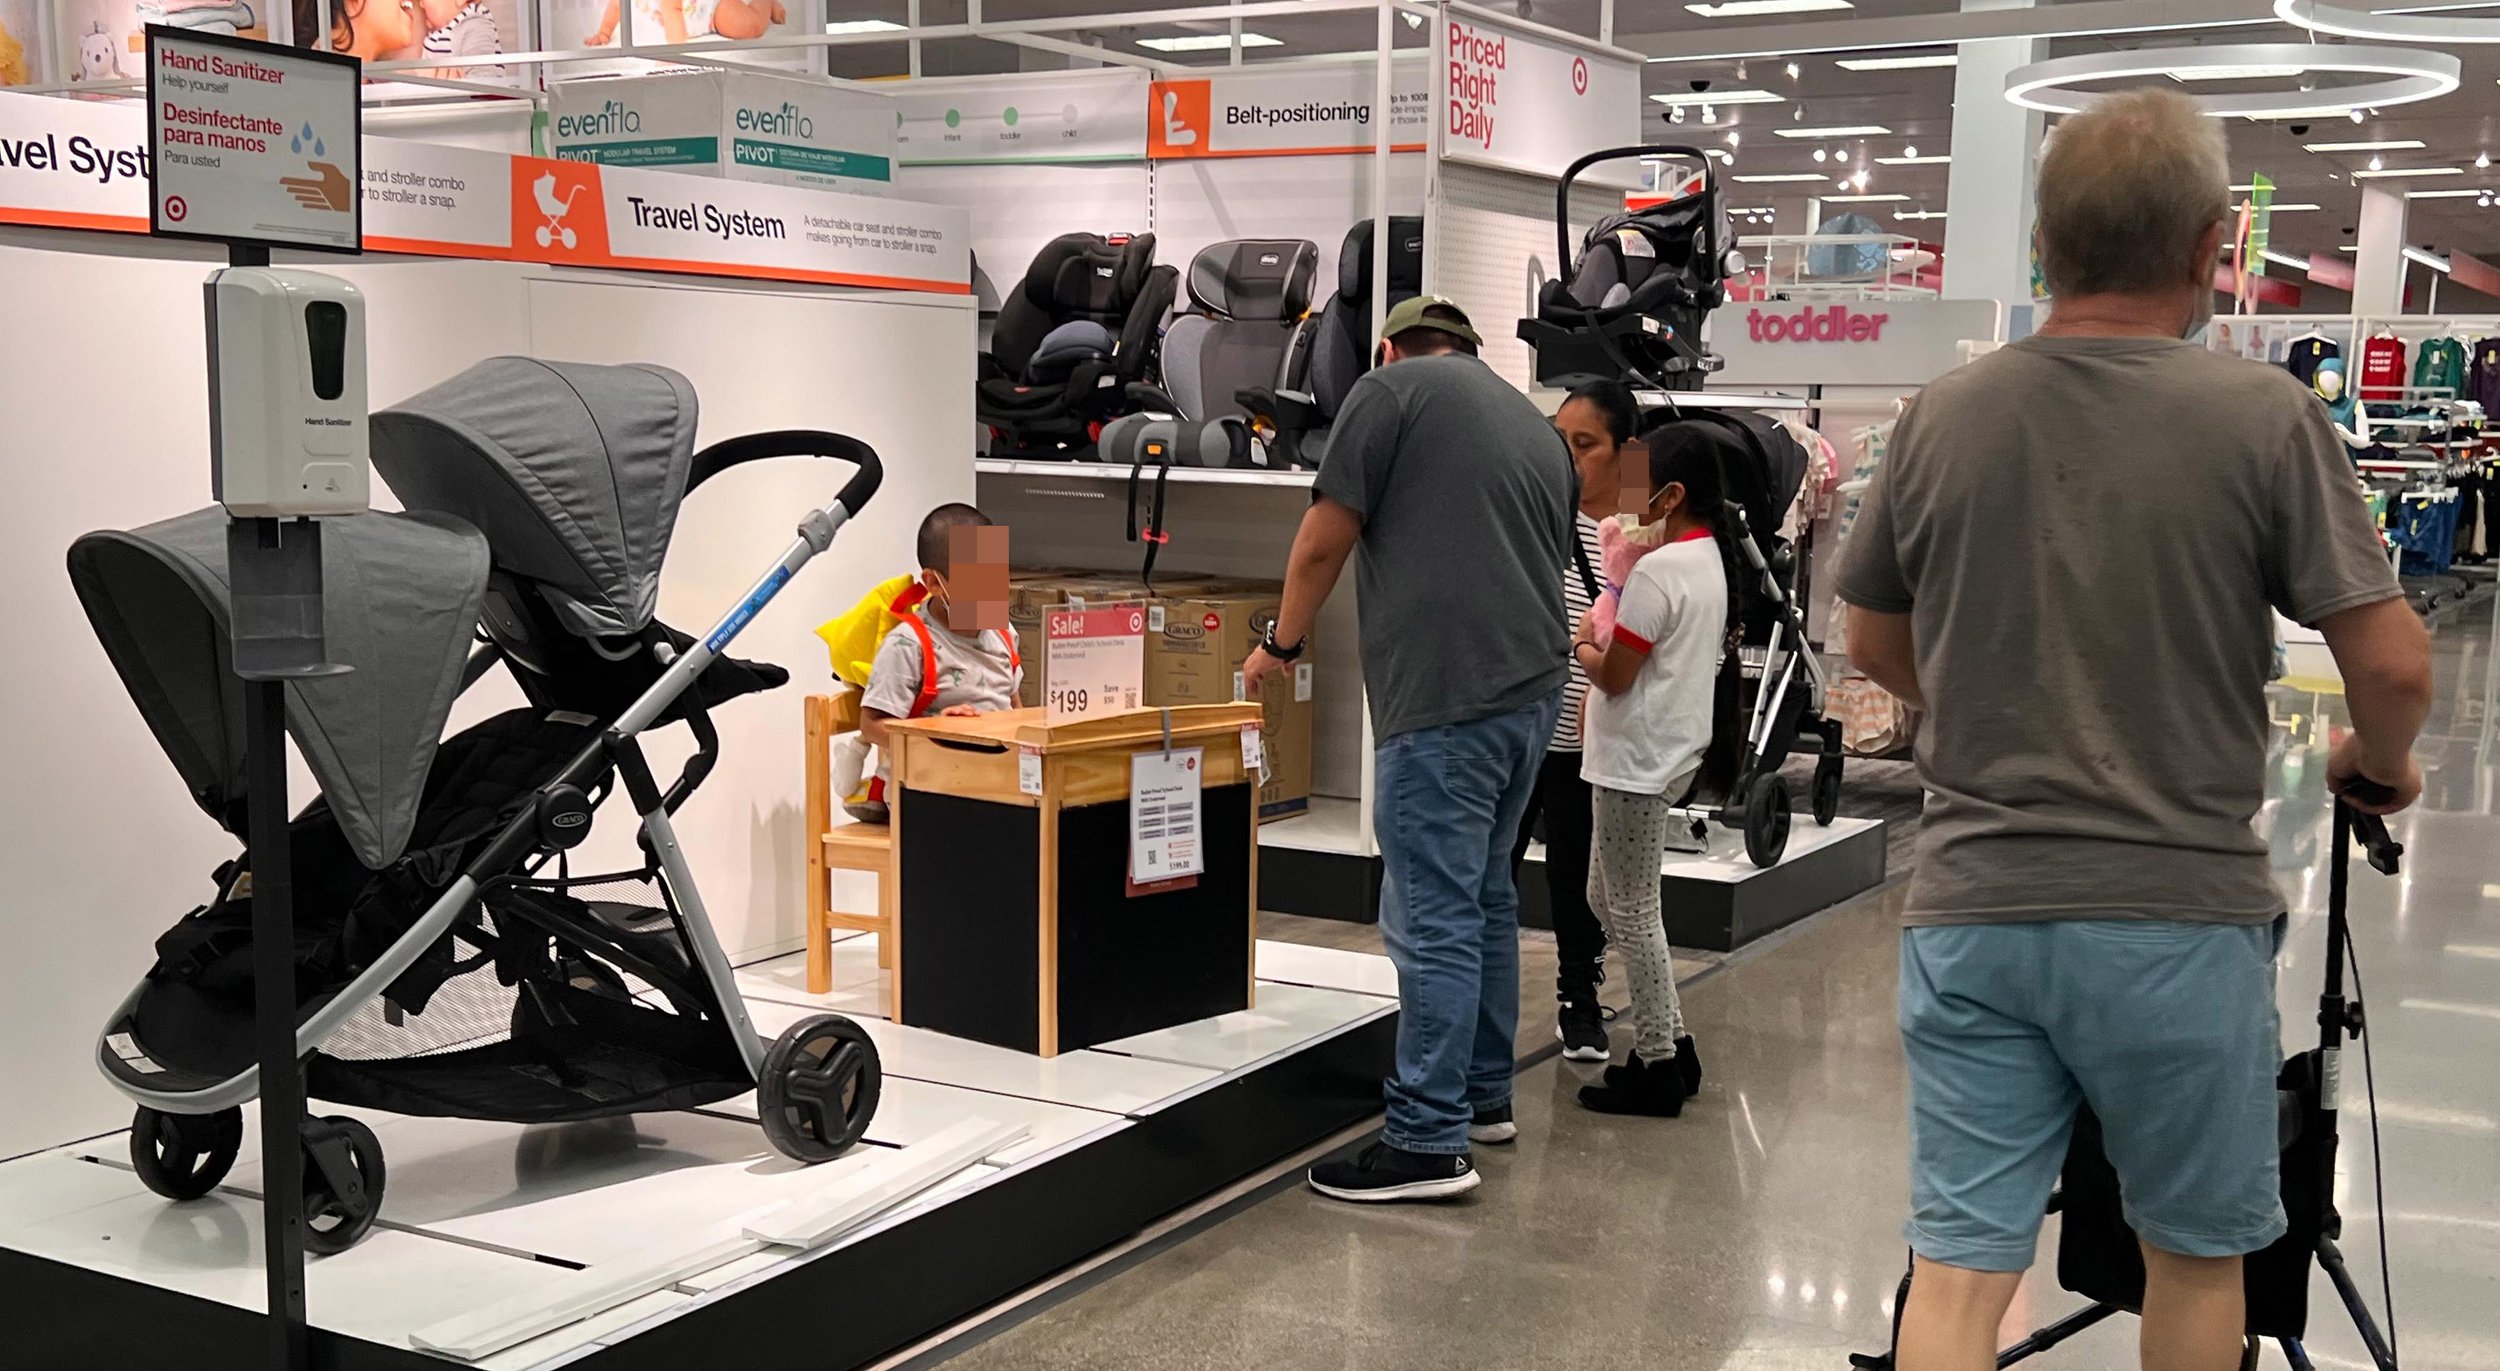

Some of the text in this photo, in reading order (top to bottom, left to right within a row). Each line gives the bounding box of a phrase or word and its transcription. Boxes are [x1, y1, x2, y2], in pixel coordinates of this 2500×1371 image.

[1449, 22, 1505, 70] Priced
[161, 48, 285, 84] Hand Sanitizer
[162, 74, 229, 94] Help yourself
[1450, 61, 1496, 109] Right
[163, 102, 283, 135] Desinfectante
[557, 100, 640, 137] evenflo
[736, 102, 813, 139] evenflo
[1226, 102, 1370, 127] Belt-positioning
[1450, 99, 1494, 149] Daily
[0, 133, 58, 171] vel
[164, 127, 266, 153] para manos
[164, 150, 220, 168] Para usted
[736, 144, 775, 163] PIVOT
[368, 169, 465, 191] and stroller combo
[369, 188, 380, 200] to
[382, 188, 417, 204] stroller
[420, 194, 427, 205] a
[628, 196, 786, 241] Travel System
[804, 215, 942, 240] A detachable car seat and stroller combo
[806, 231, 831, 243] makes
[832, 234, 852, 248] going
[853, 235, 870, 247] from
[871, 239, 882, 249] car
[883, 239, 891, 249] to
[892, 239, 913, 251] stroller
[1747, 305, 1889, 343] toddler
[305, 417, 352, 427] Hand Sanitizer
[1051, 615, 1084, 635] Sale!
[1168, 626, 1200, 636] GRACO
[1051, 689, 1088, 713] $199
[1104, 684, 1119, 693] Save
